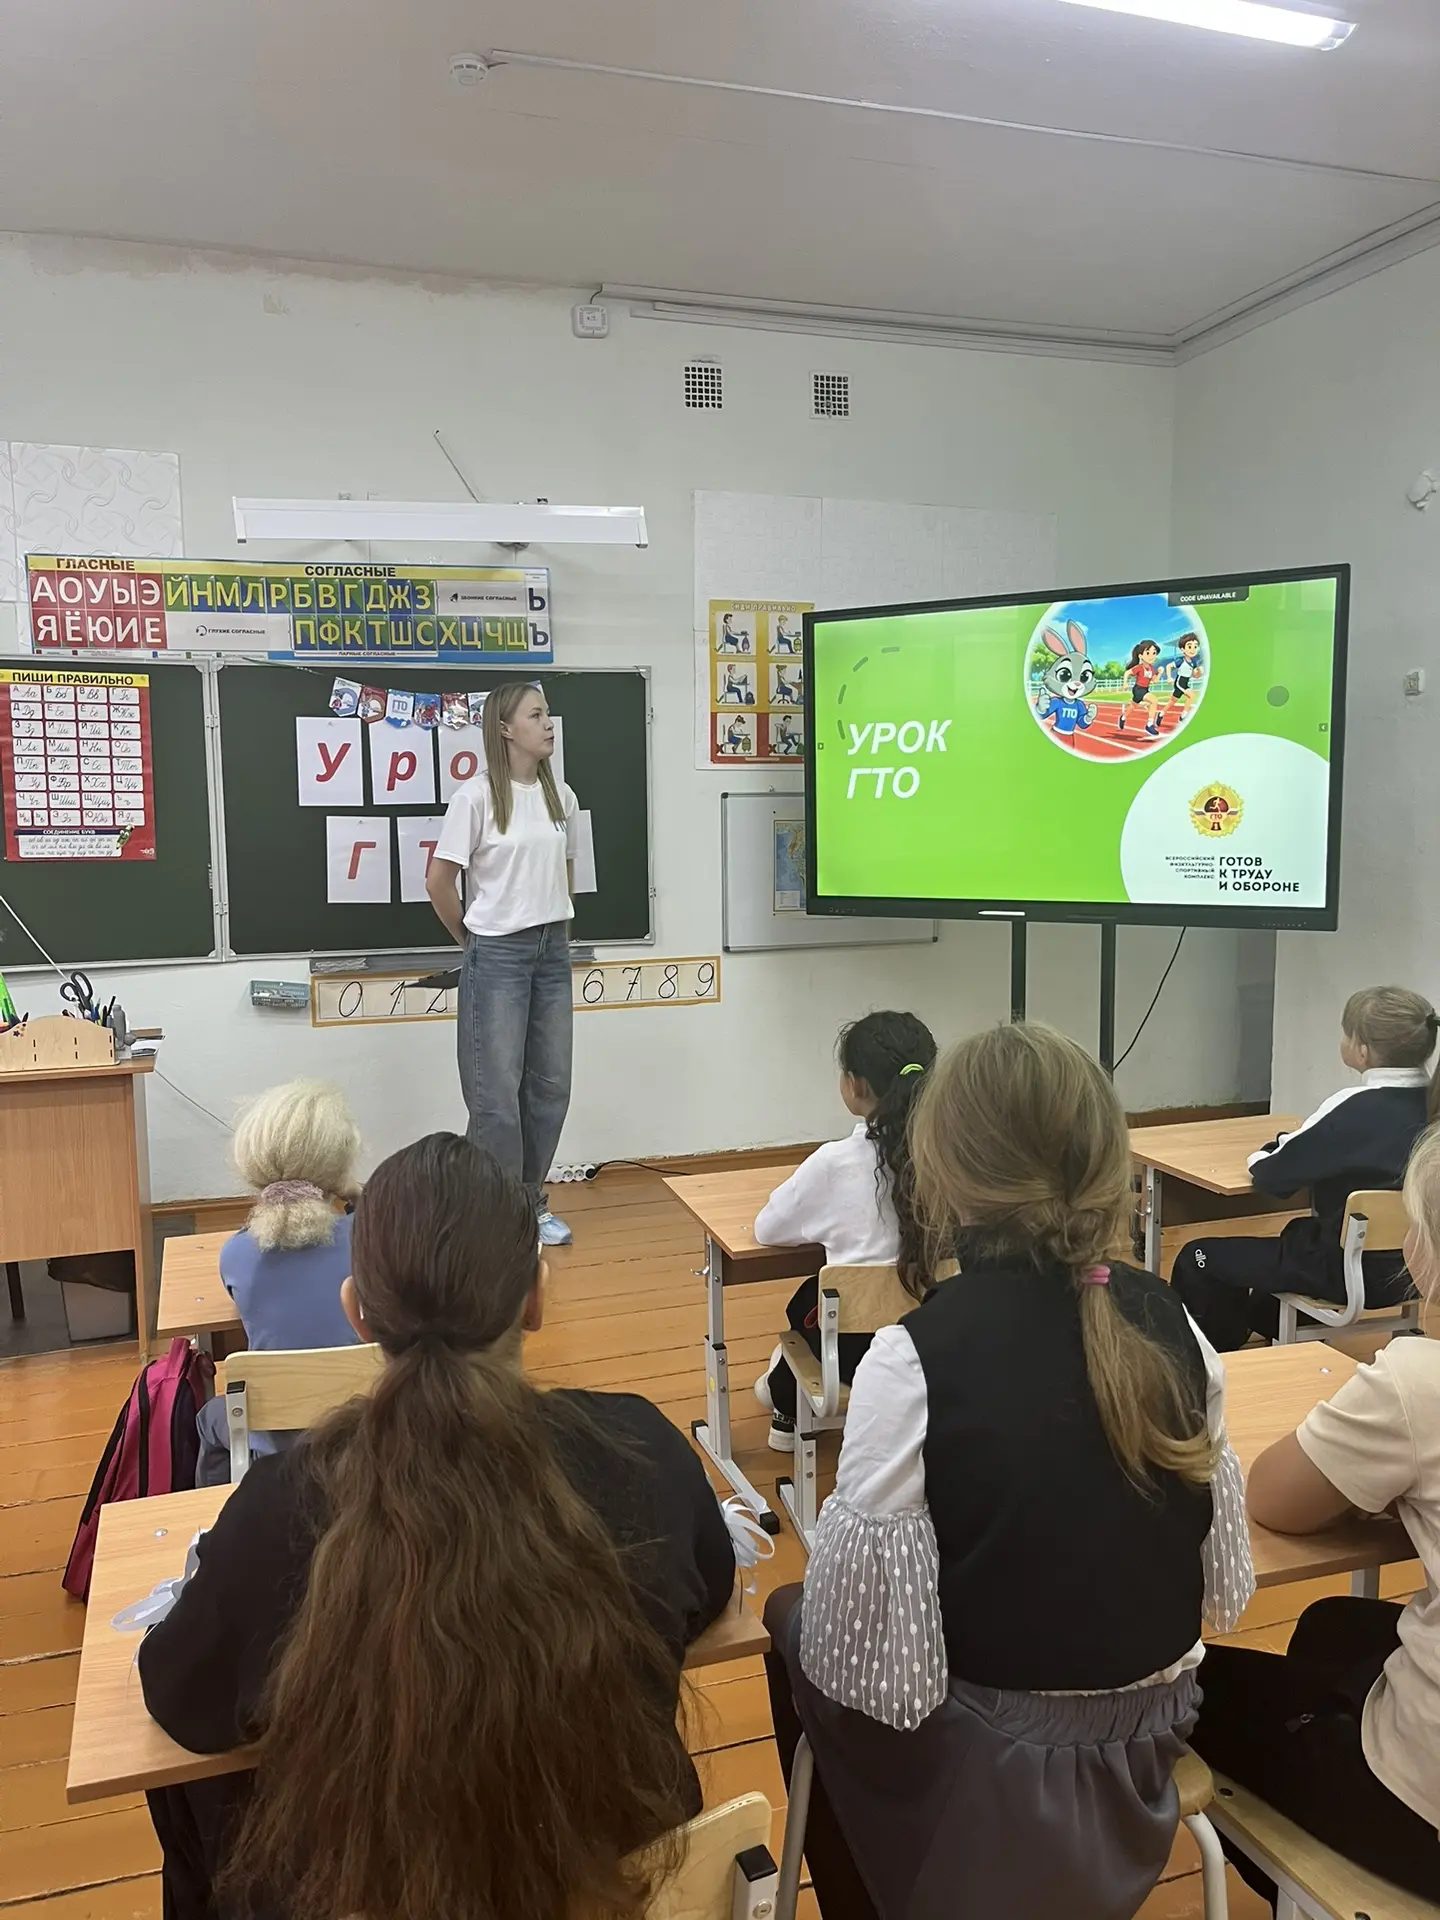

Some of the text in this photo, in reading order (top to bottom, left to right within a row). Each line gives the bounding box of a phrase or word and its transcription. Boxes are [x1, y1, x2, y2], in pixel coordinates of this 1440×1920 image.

[56, 558, 136, 571] ГЛАСНЫЕ
[304, 565, 396, 577] СОГЛАСНЫЕ
[1197, 592, 1236, 601] UNAVAILABLE
[12, 672, 134, 685] ПИШИ ПРАВИЛЬНО
[1061, 707, 1077, 719] ГТО
[847, 719, 952, 756] УРОК
[846, 766, 921, 799] ГТО
[1219, 856, 1263, 867] ГОТОВ
[1219, 869, 1273, 880] К ТРУДУ
[1219, 881, 1300, 892] И ОБОРОНЕ
[582, 962, 715, 1004] 6 7 8 9
[390, 981, 406, 1016] 1
